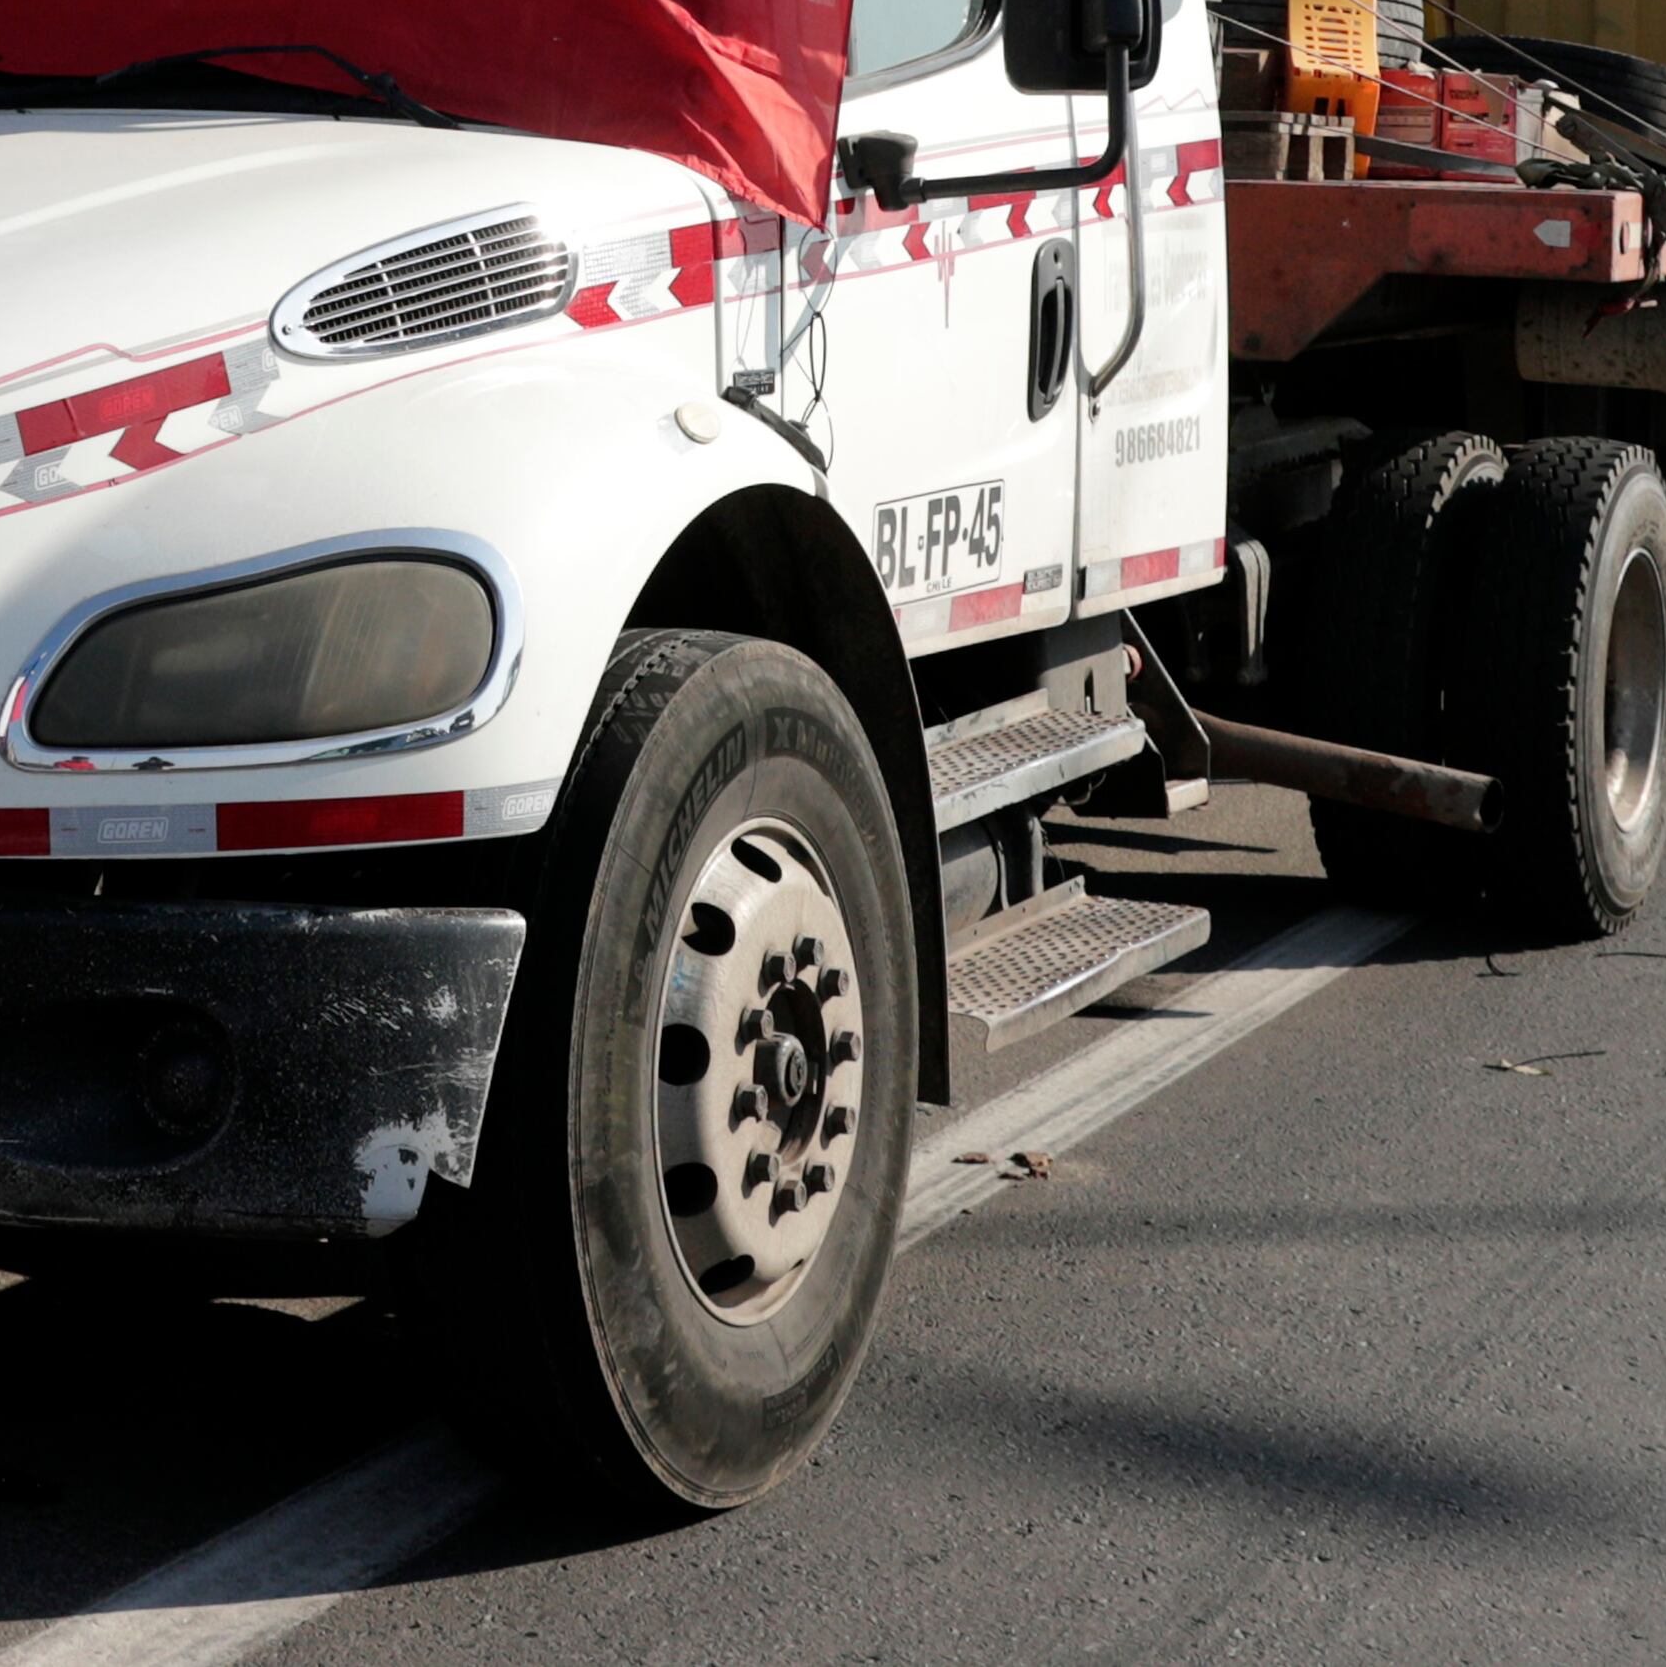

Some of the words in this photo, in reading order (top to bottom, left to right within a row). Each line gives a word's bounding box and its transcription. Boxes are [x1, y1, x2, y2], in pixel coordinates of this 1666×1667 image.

[1115, 414, 1201, 468] 986684821
[506, 793, 553, 816] GOREN
[102, 818, 166, 842] GOREN
[644, 726, 745, 944] MICHELIN
